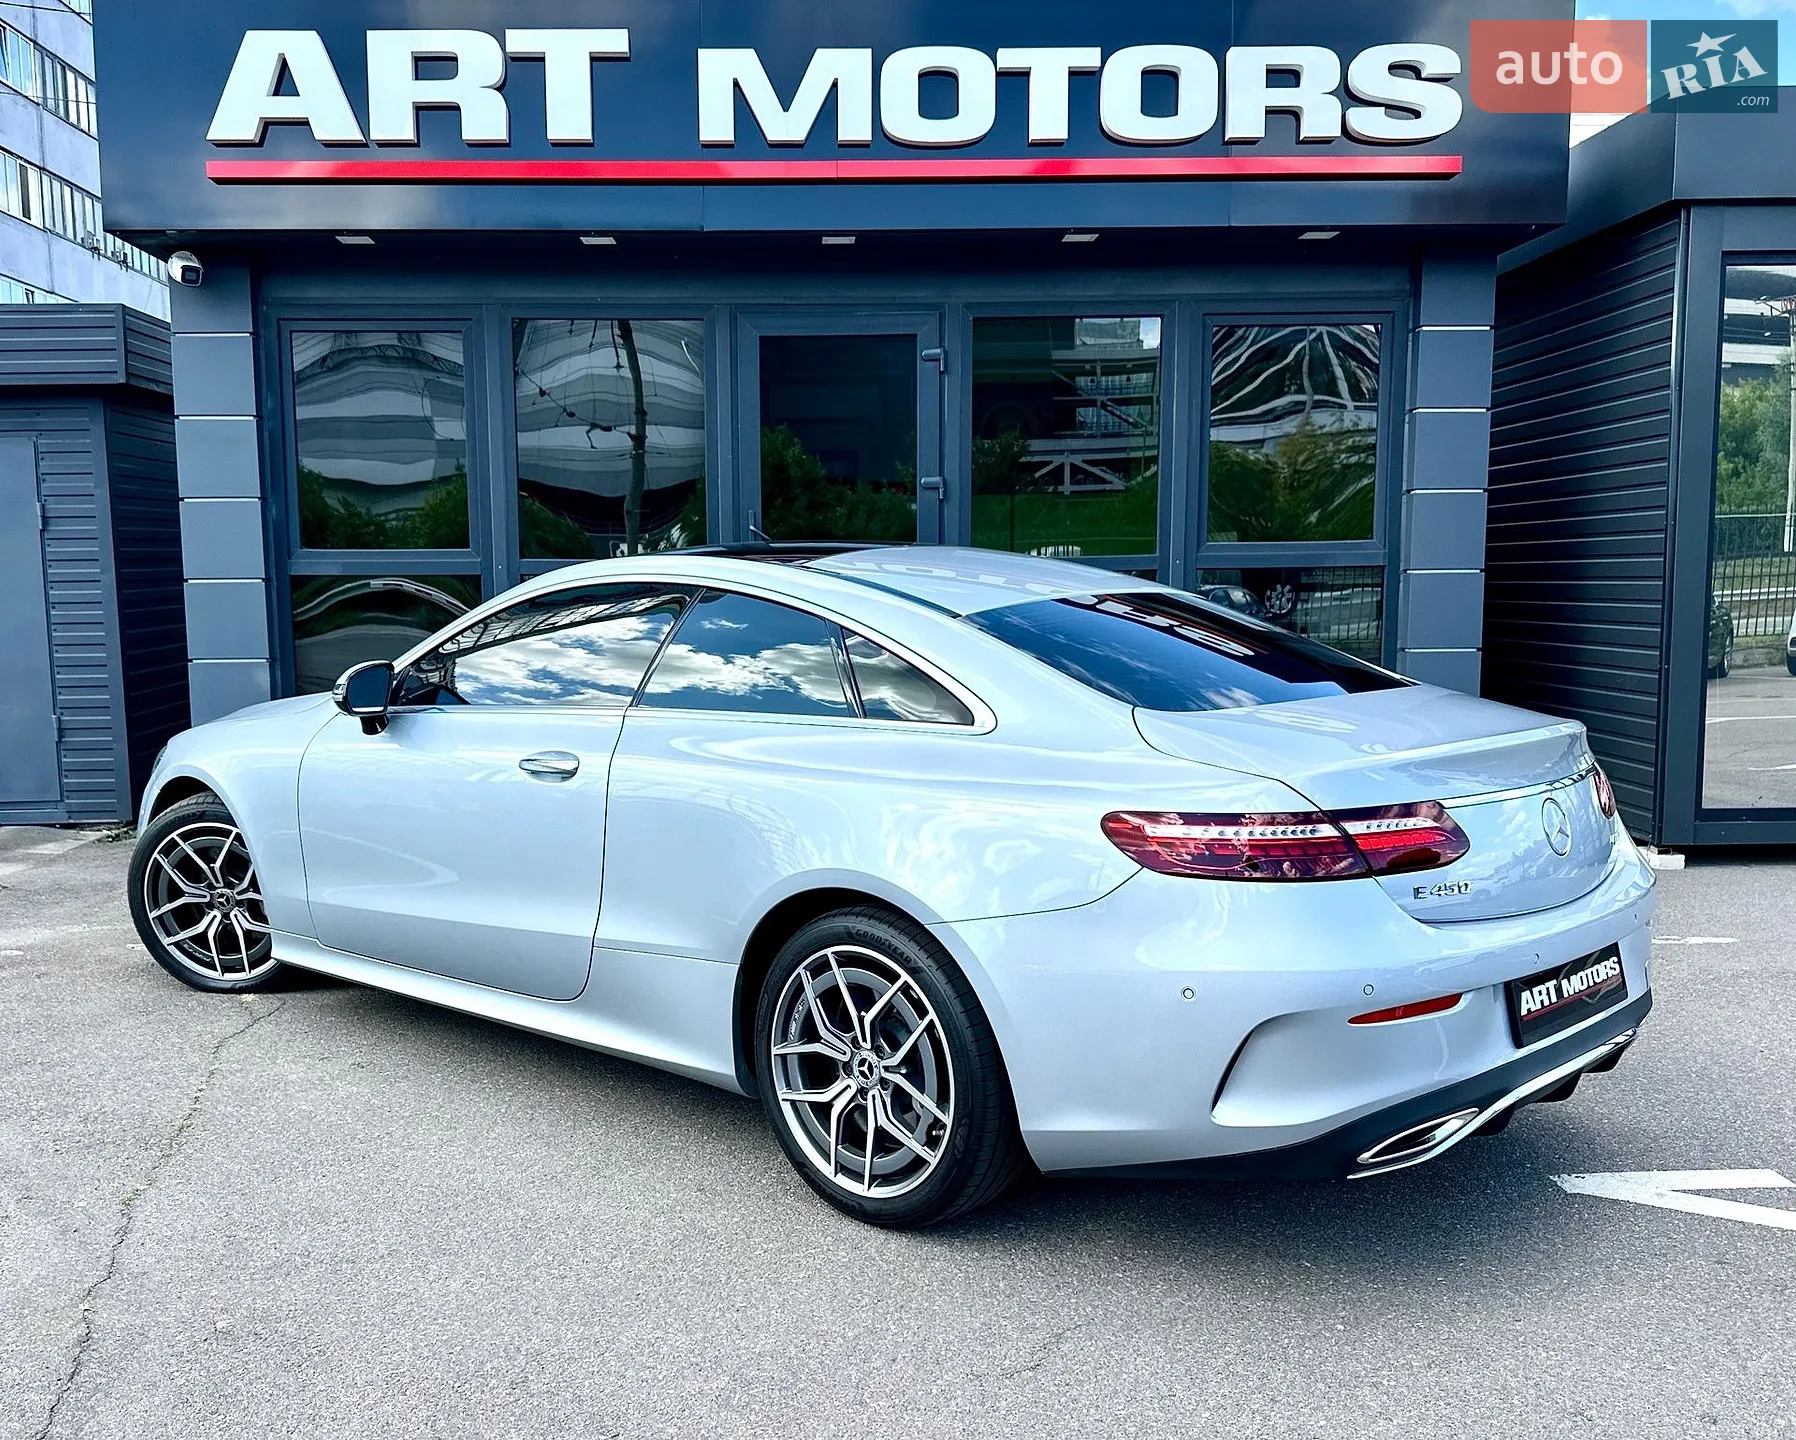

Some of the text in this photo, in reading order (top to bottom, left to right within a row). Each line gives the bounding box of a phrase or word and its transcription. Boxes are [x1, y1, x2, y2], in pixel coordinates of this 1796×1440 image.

[206, 28, 1463, 145] ART MOTORS
[1412, 880, 1473, 900] E 450
[855, 928, 913, 965] GOODYEAR
[1519, 956, 1621, 1017] ART MOTORS
